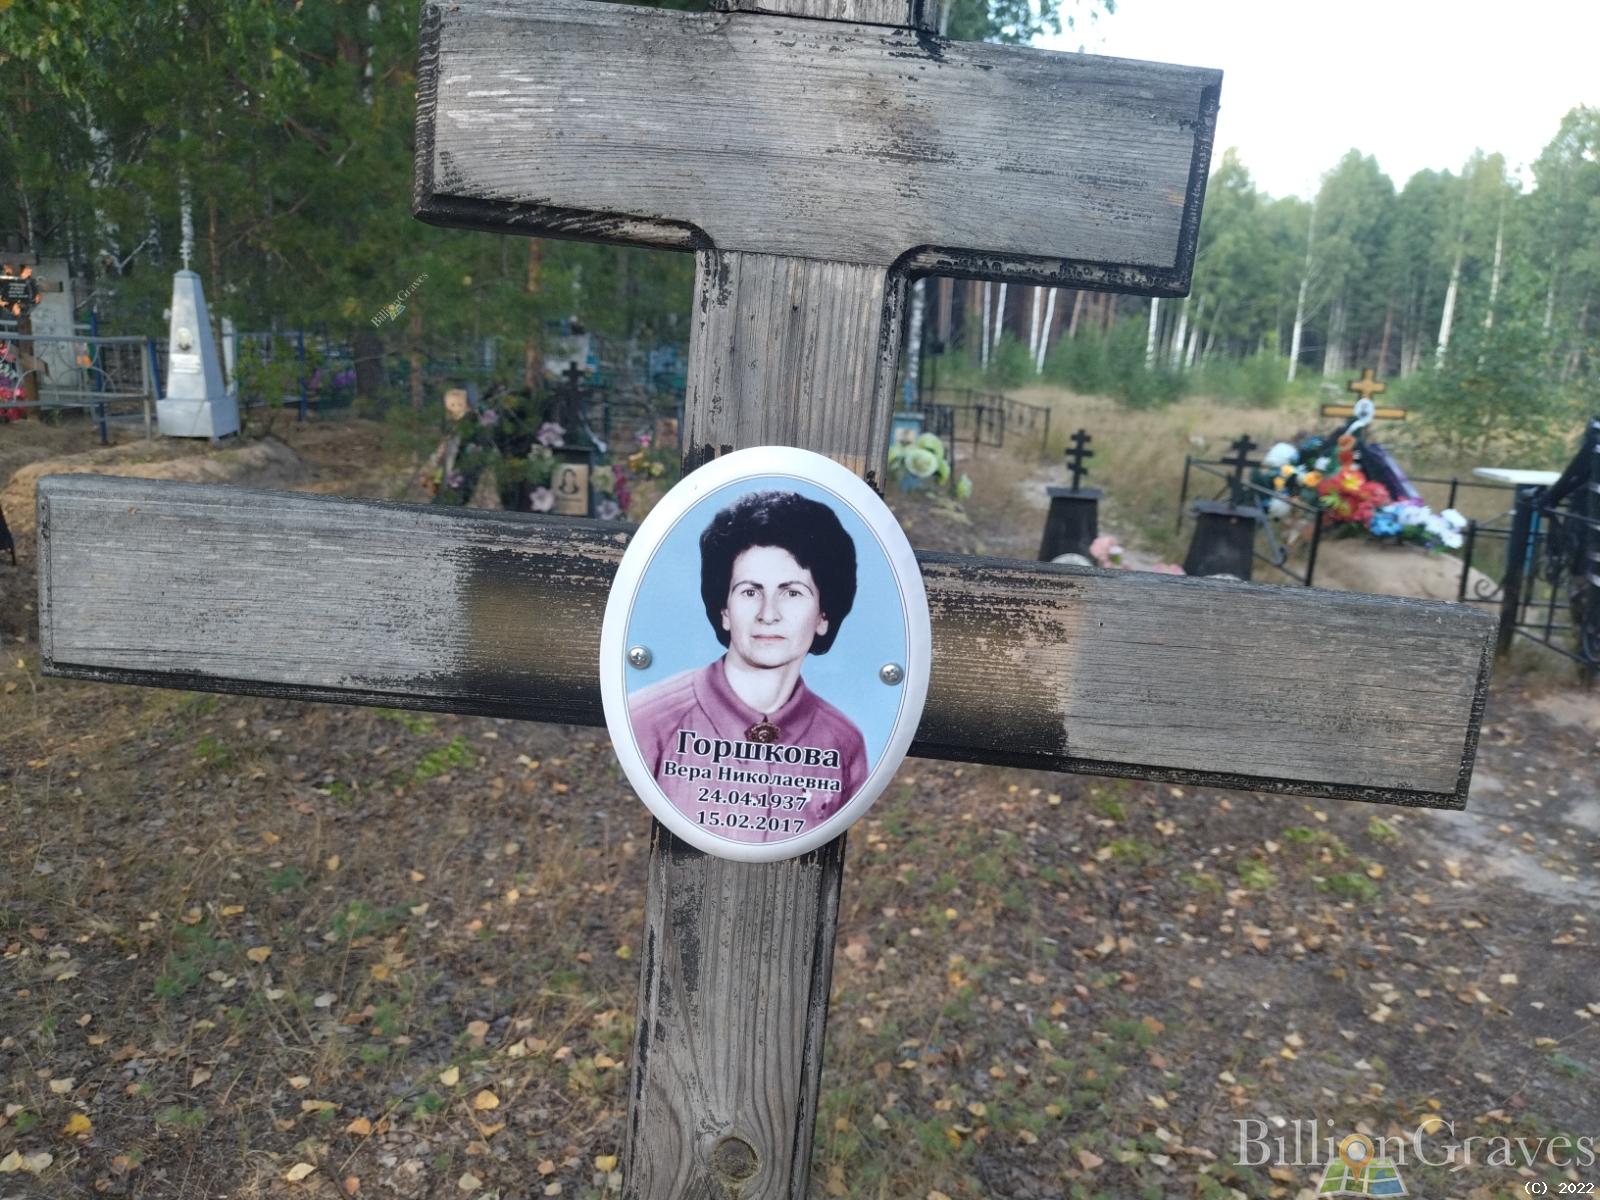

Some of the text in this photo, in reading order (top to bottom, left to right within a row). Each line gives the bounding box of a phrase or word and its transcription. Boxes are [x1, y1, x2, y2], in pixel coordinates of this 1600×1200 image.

[677, 730, 840, 768] Горшкова
[664, 761, 841, 791] Вера Николаевна
[698, 787, 807, 811] 24.04.1937
[697, 811, 805, 833] 15.02.2017
